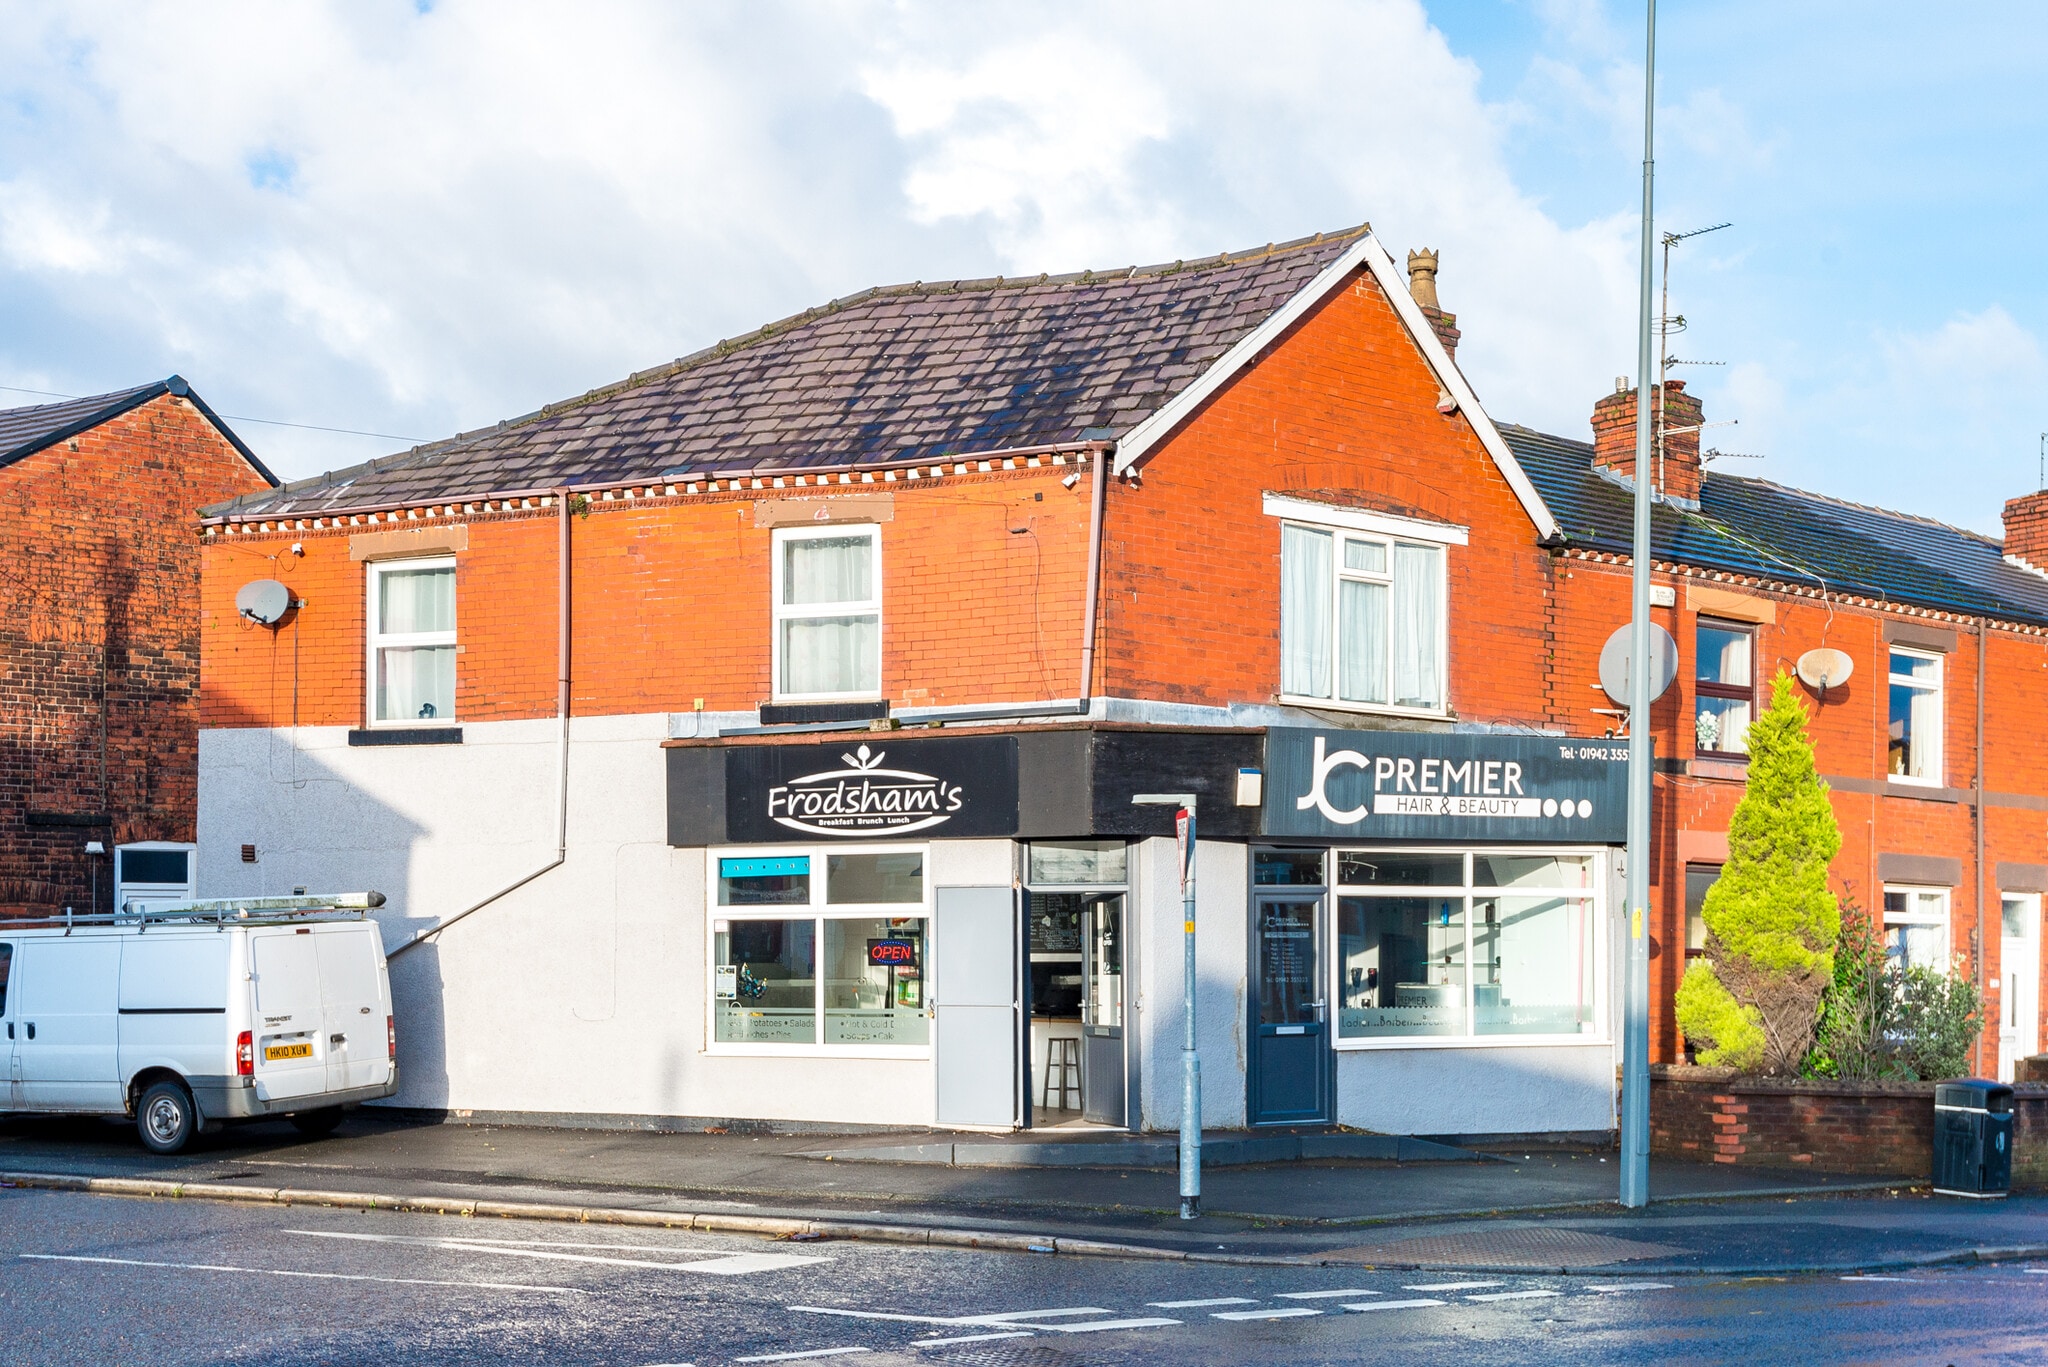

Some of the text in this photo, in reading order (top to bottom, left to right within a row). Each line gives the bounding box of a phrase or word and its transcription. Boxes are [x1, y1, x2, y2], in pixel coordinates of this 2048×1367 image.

[1580, 747, 1608, 760] 01942
[1610, 748, 1630, 761] 355
[1374, 757, 1524, 796] PREMIER
[768, 780, 962, 817] Frodsham's
[1397, 796, 1519, 815] HAIR & BEAUTY
[818, 816, 910, 827] Breakfast Brunch Lunch
[871, 945, 911, 960] OPEN
[789, 1019, 815, 1028] Salads
[270, 1046, 289, 1058] HK10
